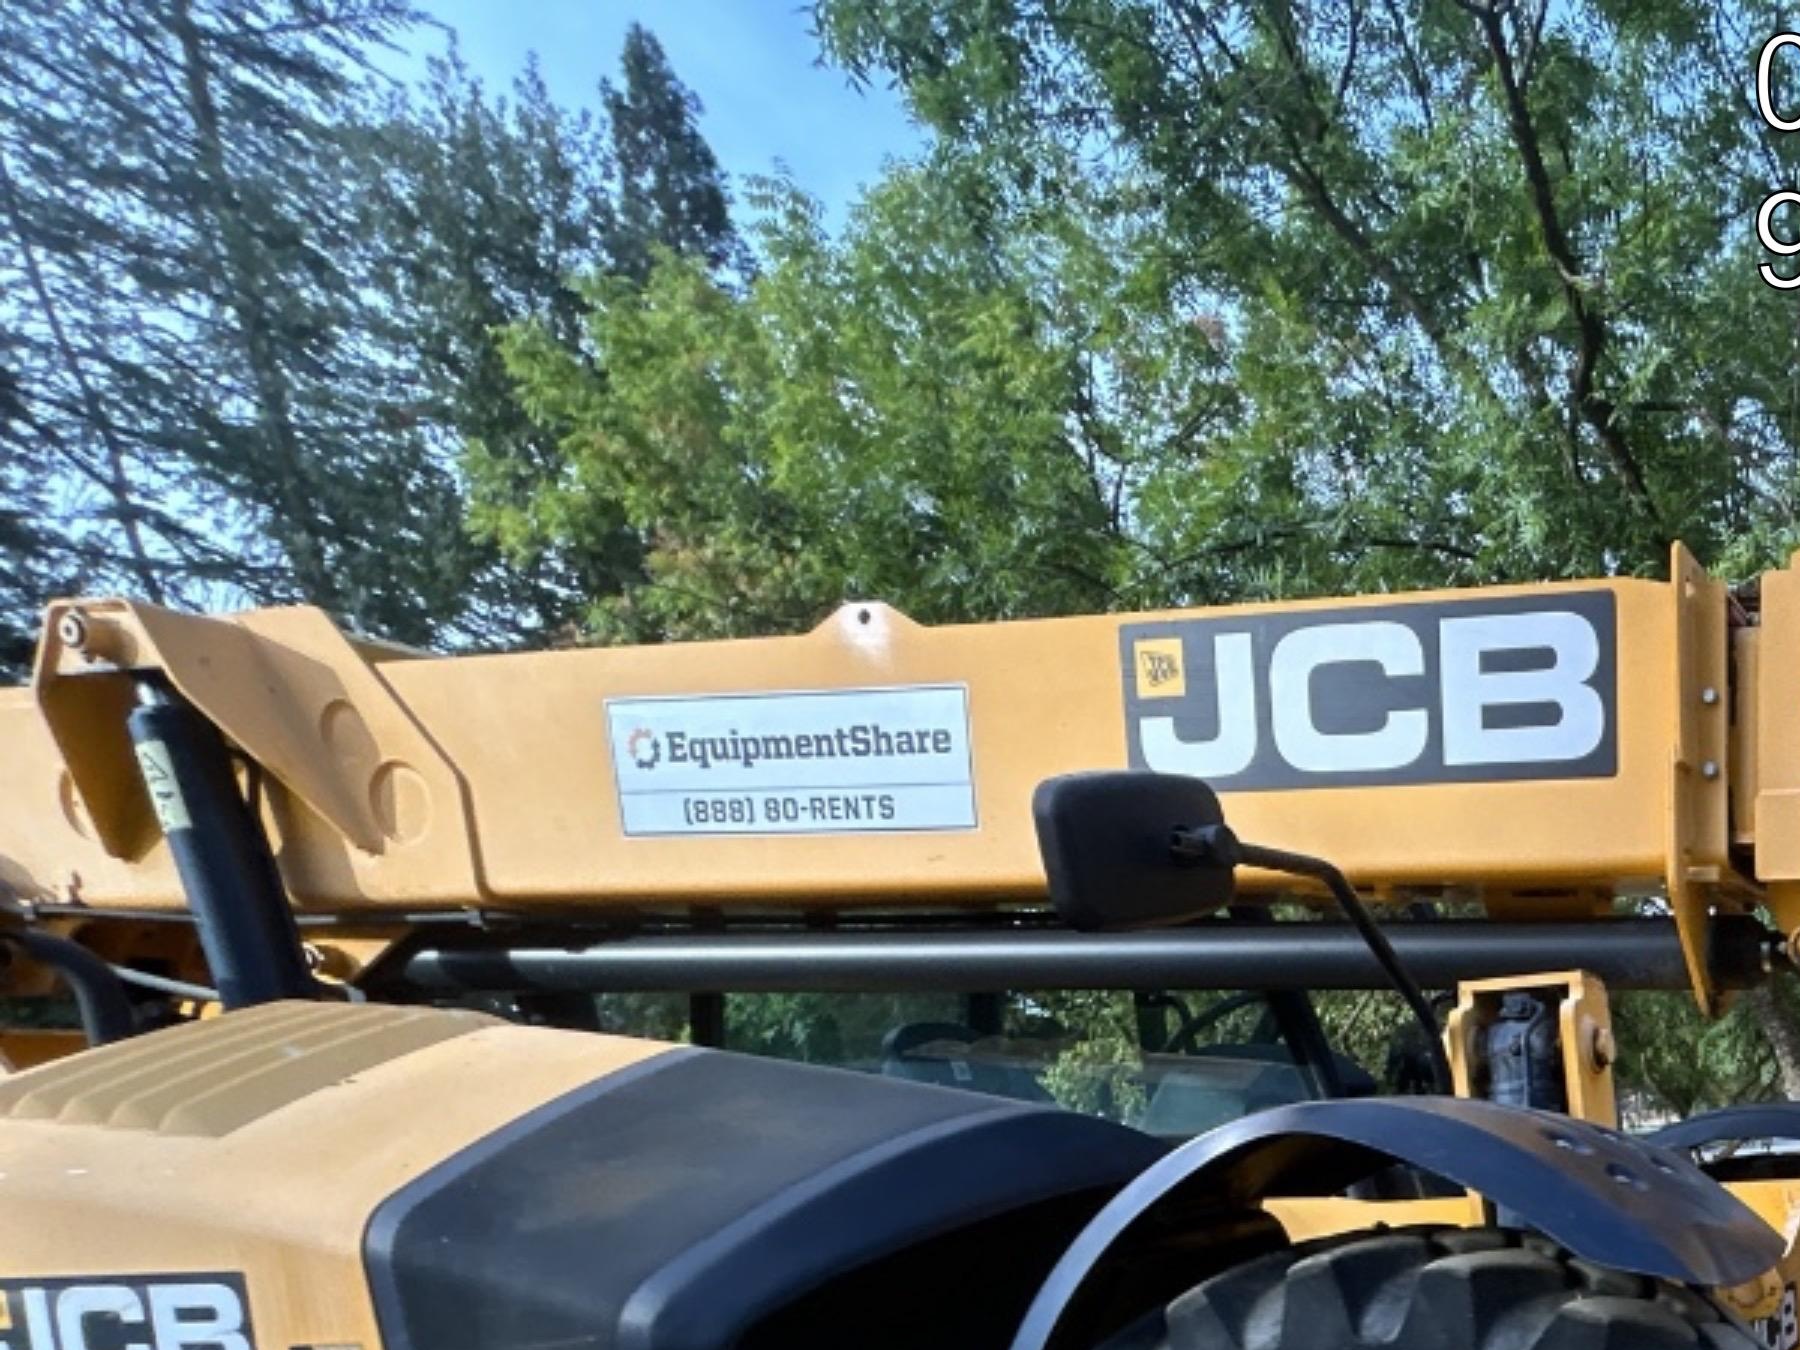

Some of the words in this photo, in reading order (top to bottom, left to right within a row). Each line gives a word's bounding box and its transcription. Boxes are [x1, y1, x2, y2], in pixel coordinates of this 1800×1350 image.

[1139, 611, 1605, 777] JCB
[665, 723, 952, 769] EquipmentShare
[683, 796, 755, 825] (888)
[764, 794, 895, 822] 80-RENTS
